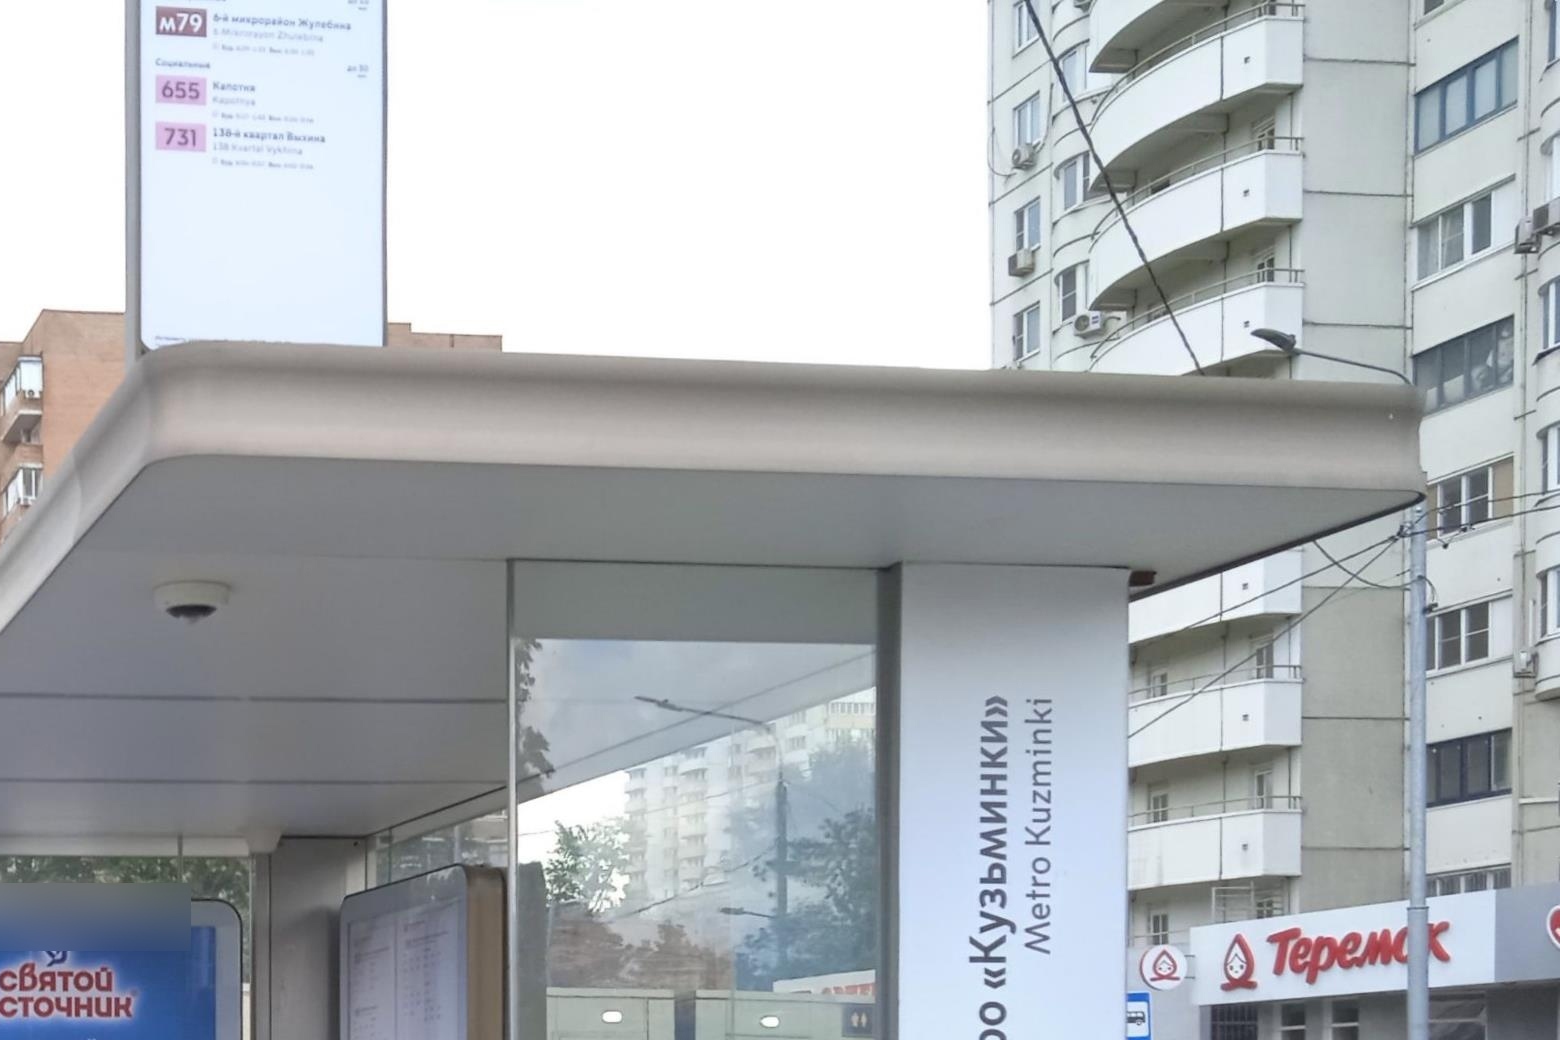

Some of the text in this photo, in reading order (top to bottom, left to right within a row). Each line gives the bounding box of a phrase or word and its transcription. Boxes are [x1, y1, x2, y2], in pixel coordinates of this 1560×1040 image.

[159, 12, 203, 32] м79
[161, 80, 200, 100] 655
[164, 127, 197, 147] 731
[243, 130, 284, 142] квартал
[1024, 697, 1053, 955] Metro Kuzminki
[969, 695, 1016, 990] «Кузьминки»
